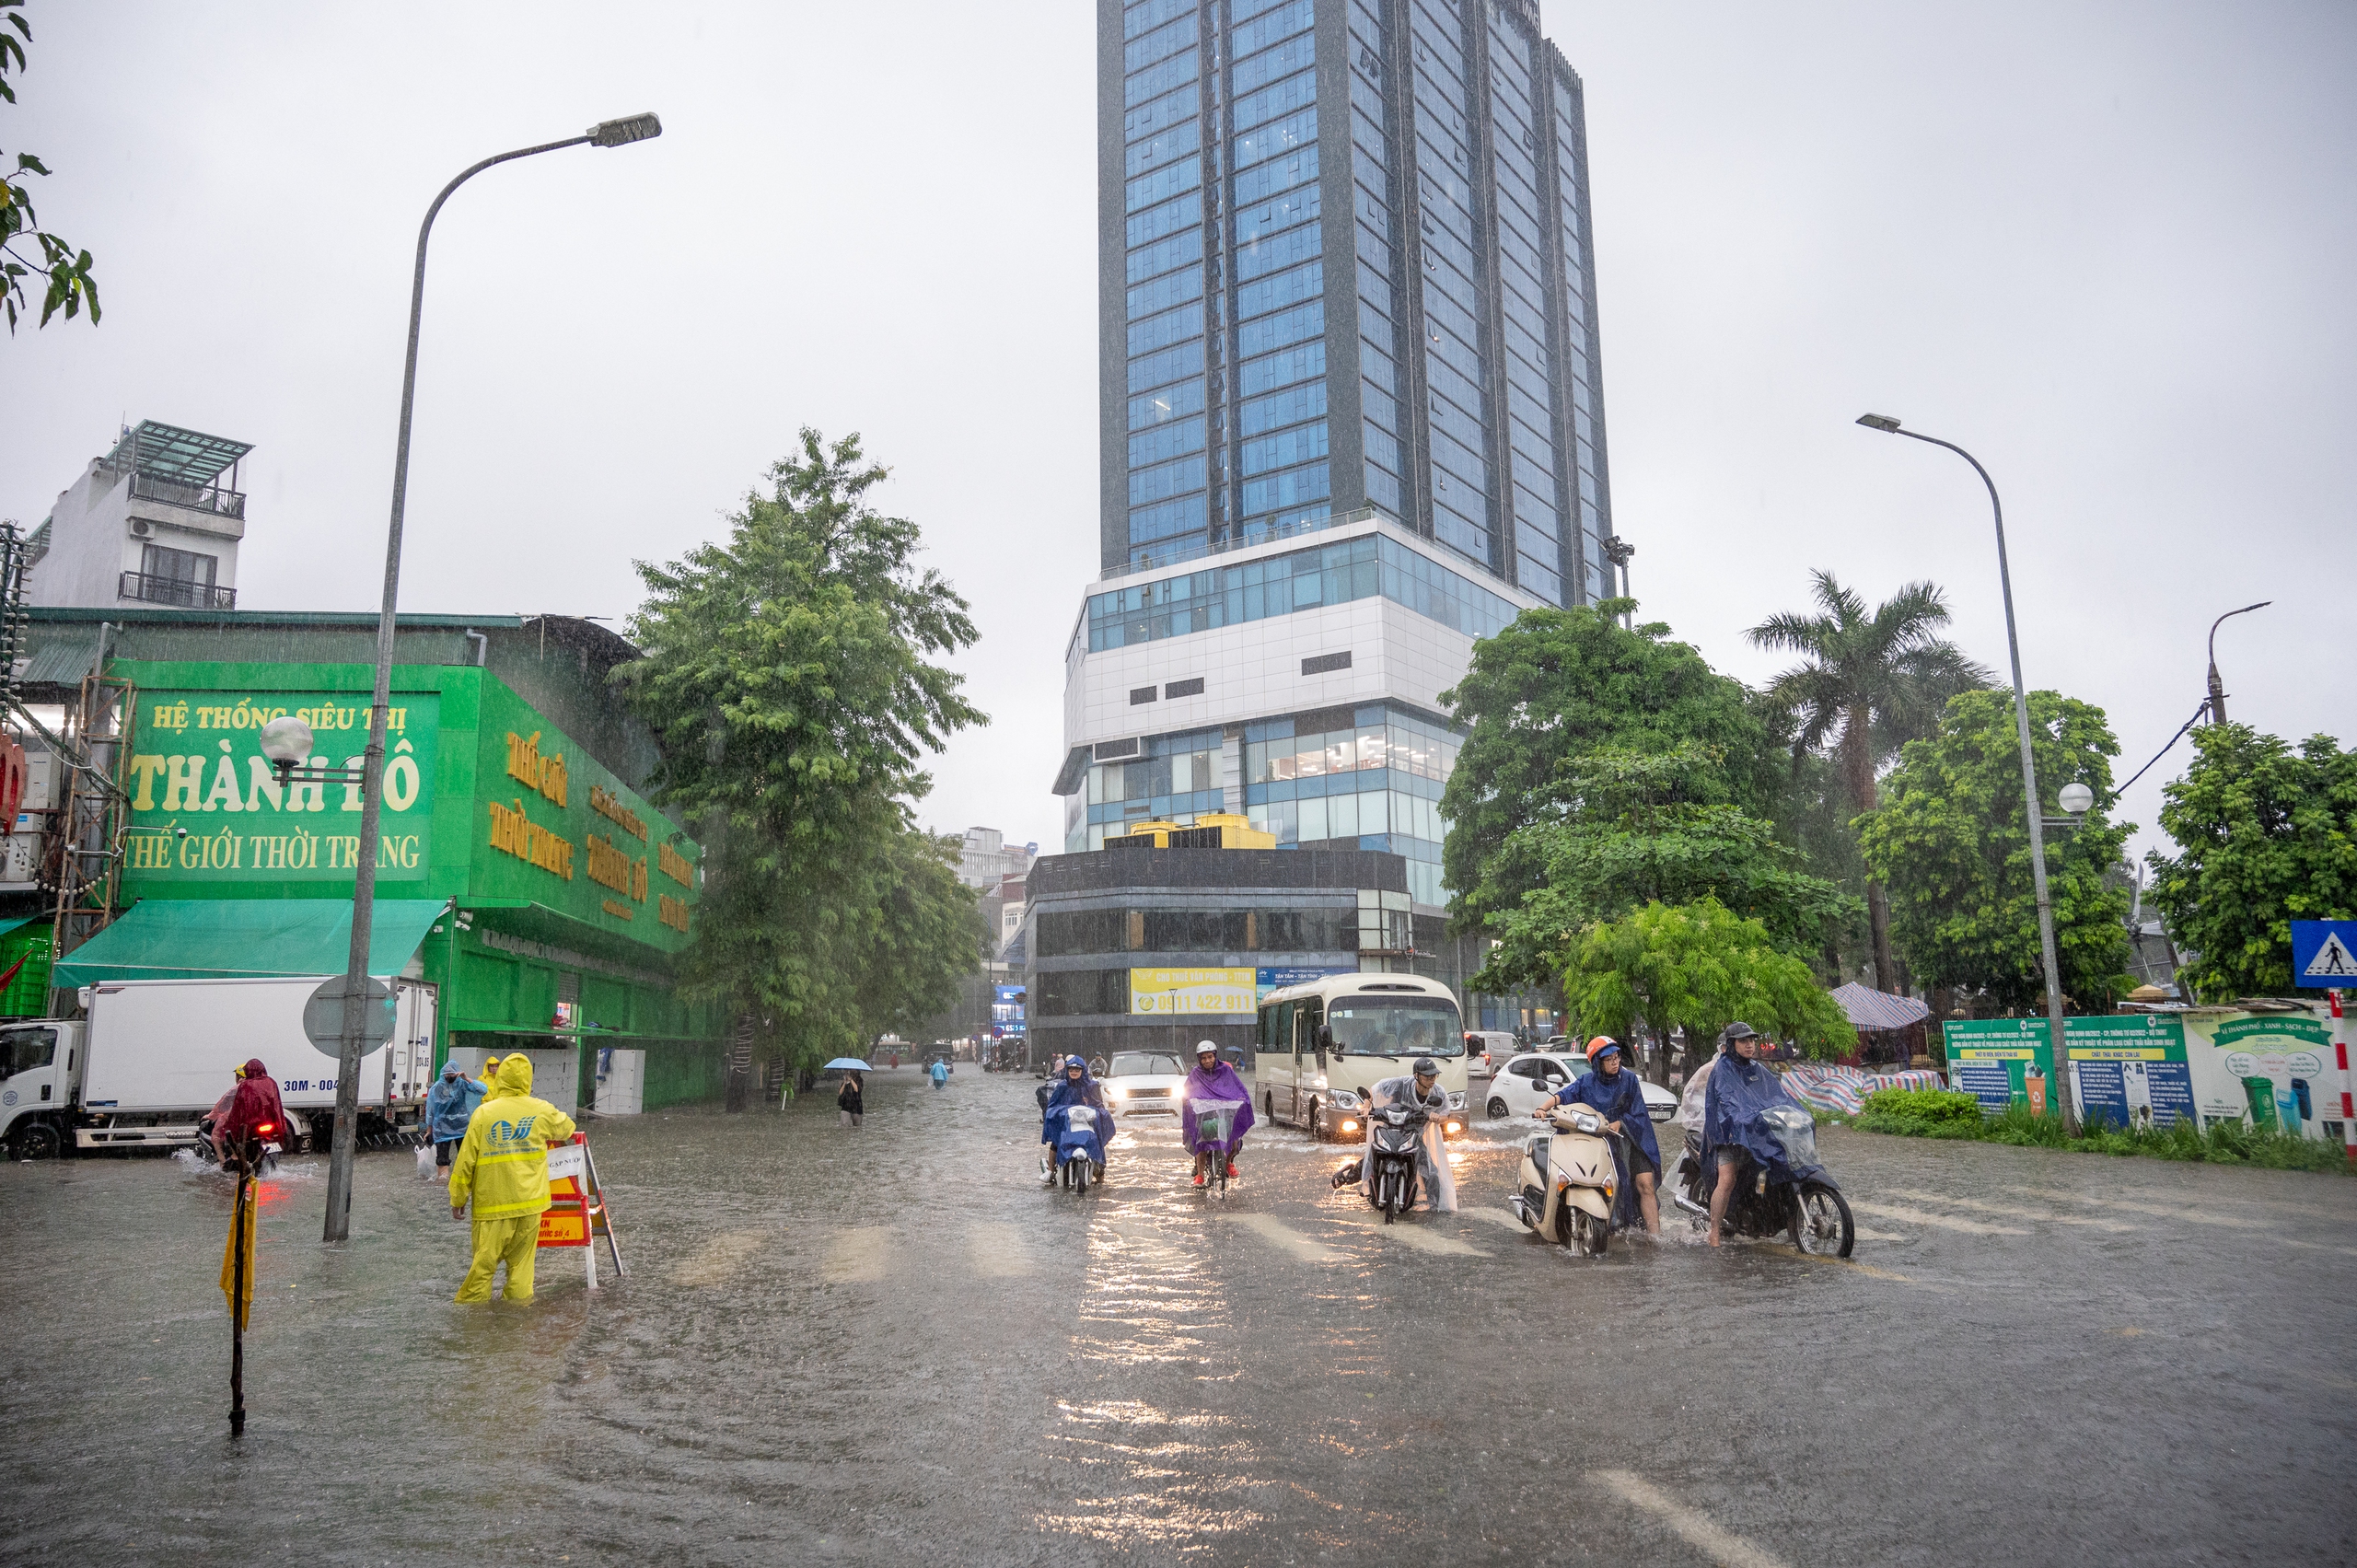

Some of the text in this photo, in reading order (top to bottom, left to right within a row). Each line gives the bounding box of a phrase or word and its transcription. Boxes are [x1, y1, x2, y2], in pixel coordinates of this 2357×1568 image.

[152, 700, 189, 735] HỆ
[196, 697, 287, 729] THỐNG
[296, 702, 355, 730] SIÊU
[131, 738, 329, 812] THÀNH
[507, 731, 540, 790] THẾ
[122, 819, 420, 869] THẾ GIỚI THỜI TRNG
[490, 798, 574, 881] THỜI TRANG
[1156, 972, 1170, 982] CHO
[1172, 971, 1189, 982] THUÊ
[1190, 971, 1203, 982] VĂN
[1205, 971, 1228, 981] PHÒNG
[1158, 994, 1250, 1011] 0911 422 911
[284, 1080, 308, 1092] 30M
[319, 1079, 339, 1091] 004
[549, 1159, 563, 1168] GẬP
